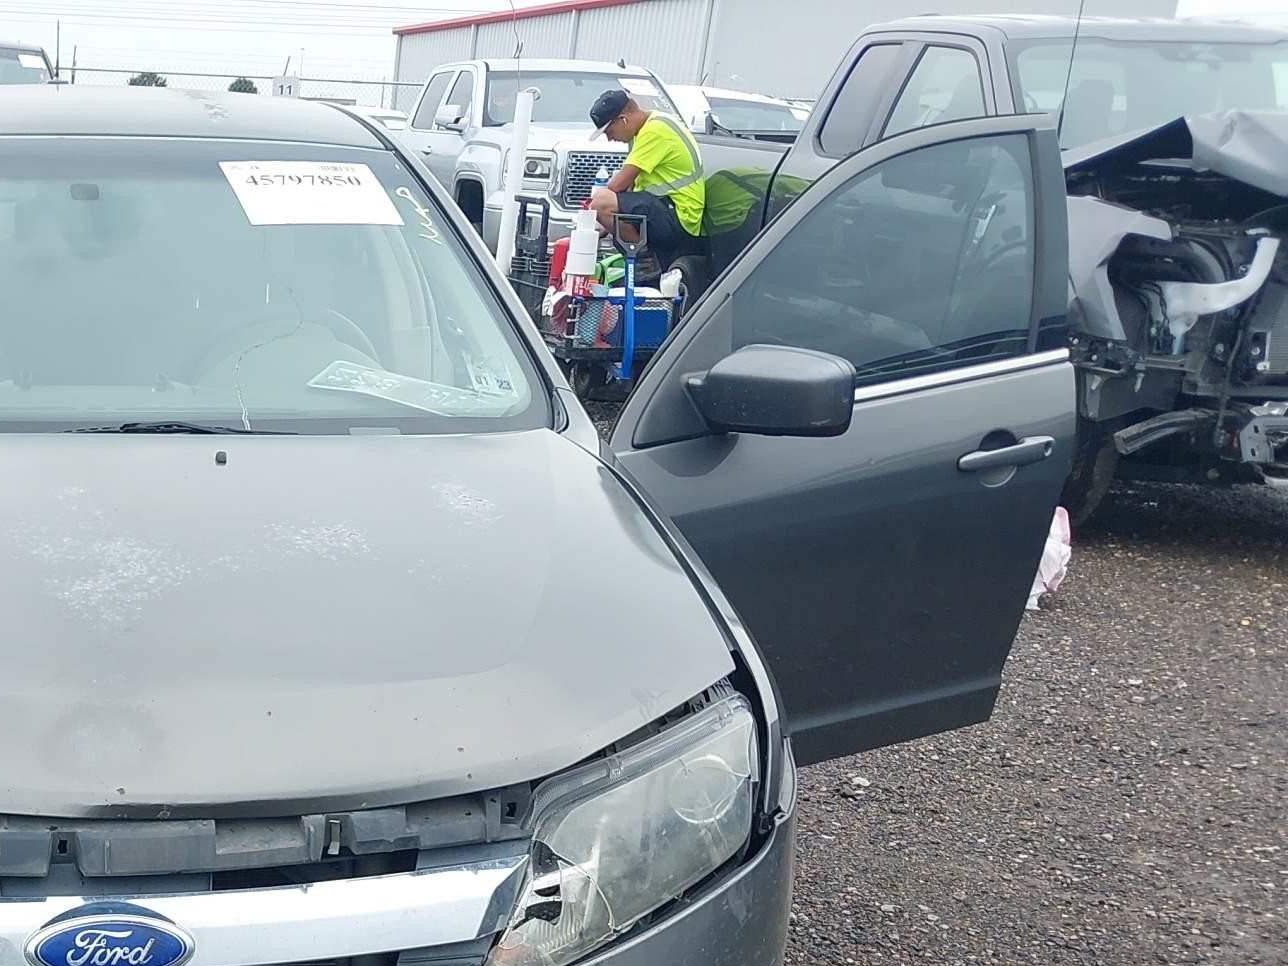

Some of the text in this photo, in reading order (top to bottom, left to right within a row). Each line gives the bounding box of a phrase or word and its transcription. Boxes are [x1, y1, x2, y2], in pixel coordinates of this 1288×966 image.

[278, 84, 292, 96] 11
[245, 174, 362, 187] 45797850
[66, 929, 155, 966] Ford
